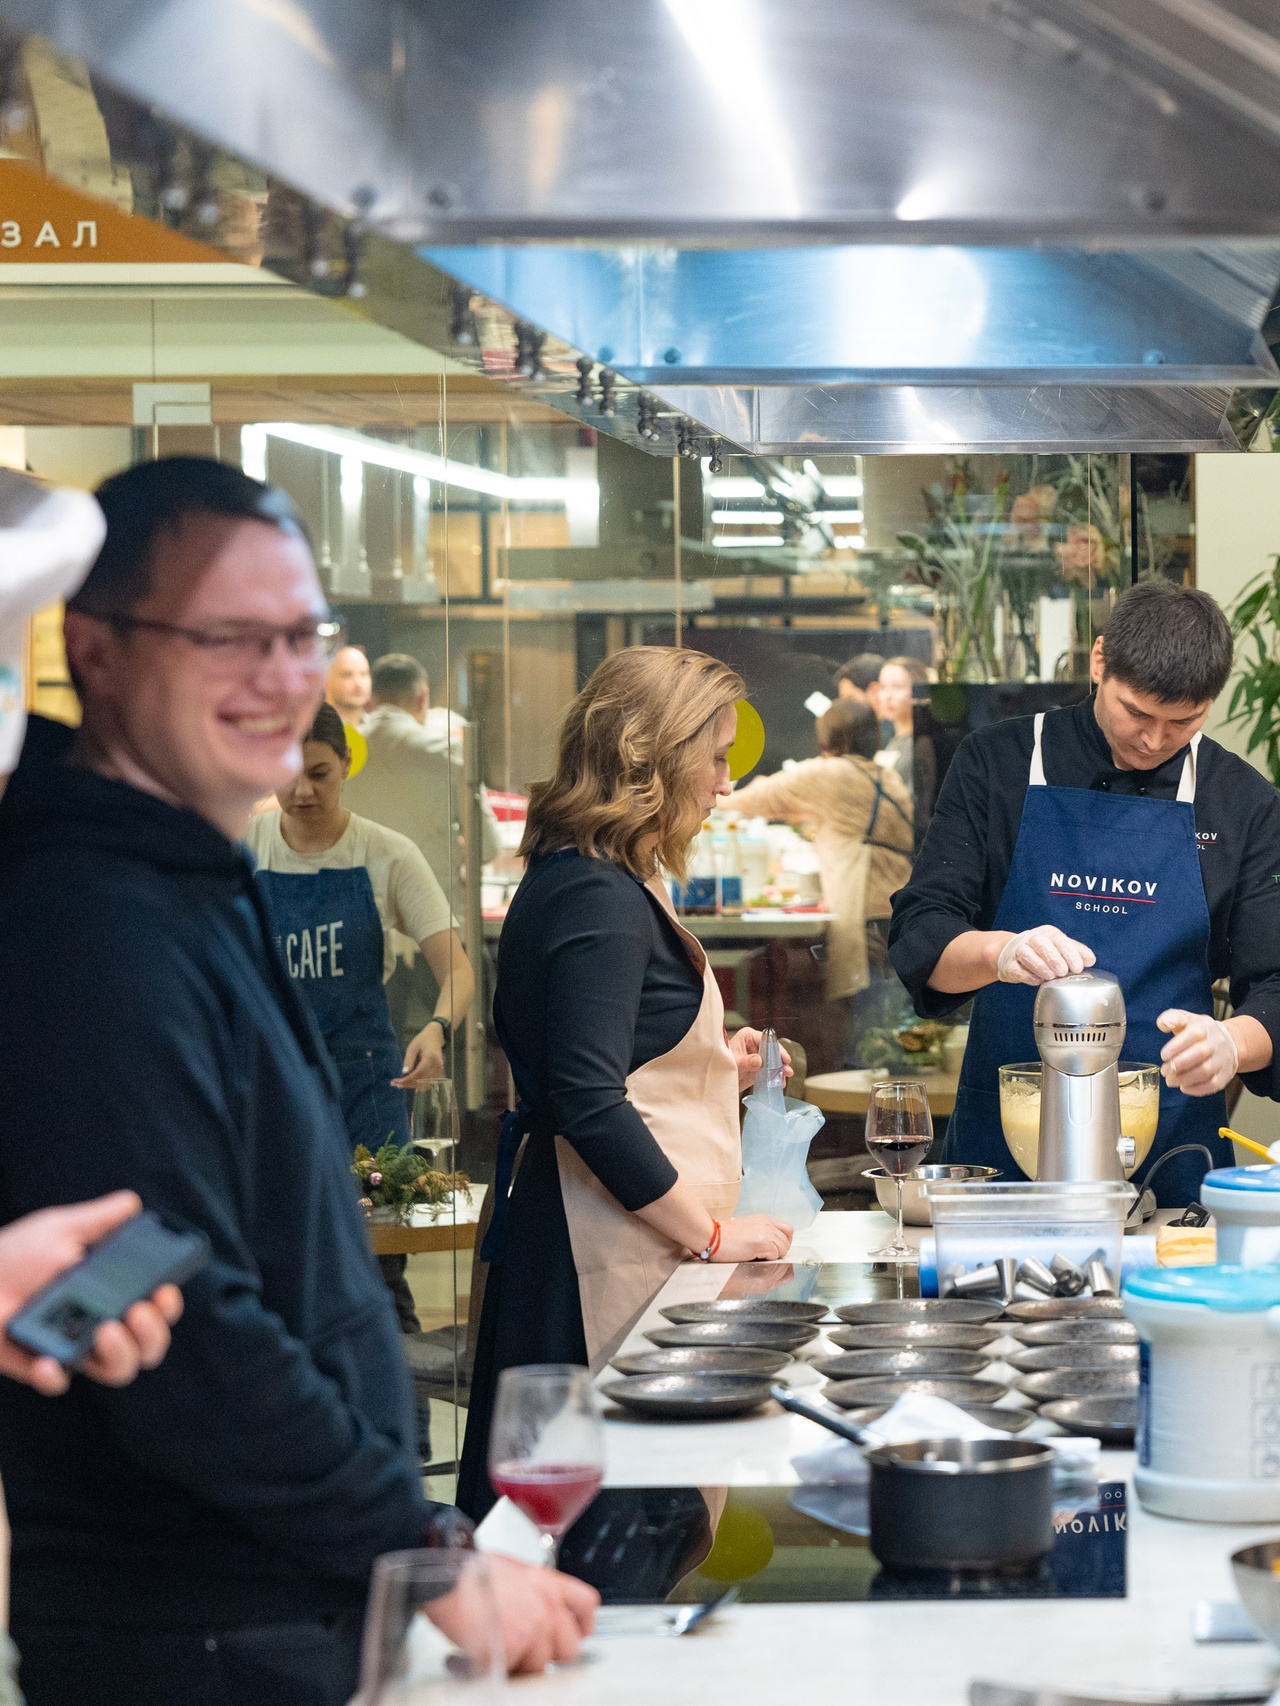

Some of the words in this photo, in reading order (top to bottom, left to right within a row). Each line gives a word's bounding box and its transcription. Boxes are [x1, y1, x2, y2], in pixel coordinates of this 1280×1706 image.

[0, 220, 98, 248] ЗАЛ
[1050, 872, 1158, 897] NOVIKOV
[1075, 902, 1128, 915] SCHOOL
[286, 920, 344, 979] CAFE
